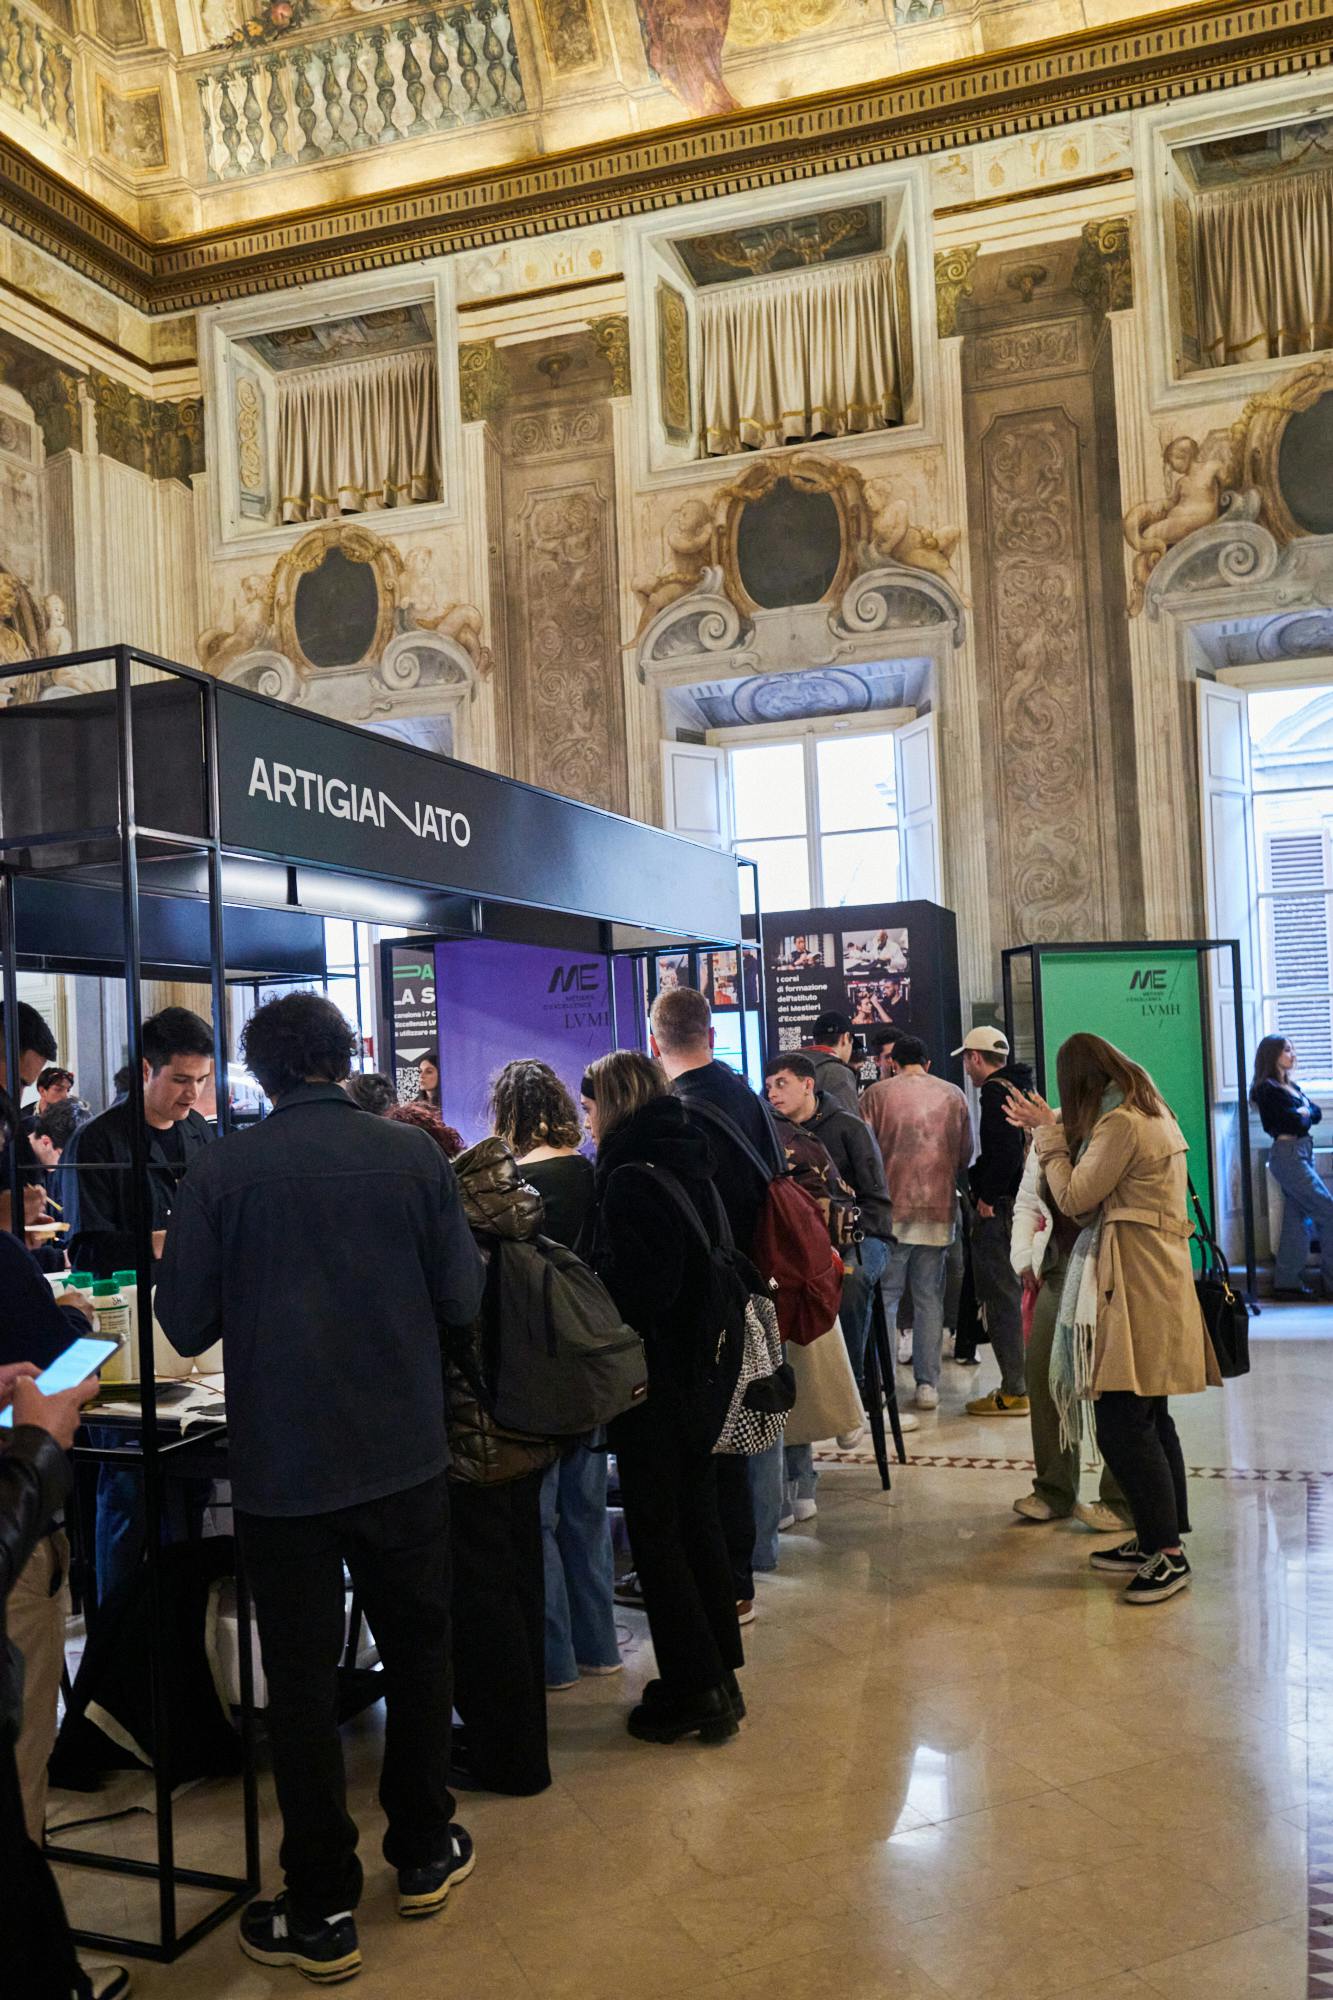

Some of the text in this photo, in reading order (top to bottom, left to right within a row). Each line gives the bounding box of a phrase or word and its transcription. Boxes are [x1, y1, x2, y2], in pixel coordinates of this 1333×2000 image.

[248, 757, 471, 848] ARTIGIANATO
[547, 963, 599, 993] ME
[780, 974, 800, 983] corsi
[1129, 969, 1167, 990] ME
[785, 984, 828, 993] formazione
[777, 994, 817, 1003] dell'Istituto
[777, 1003, 821, 1013] dei Mestieri
[1142, 1004, 1180, 1017] LVMH
